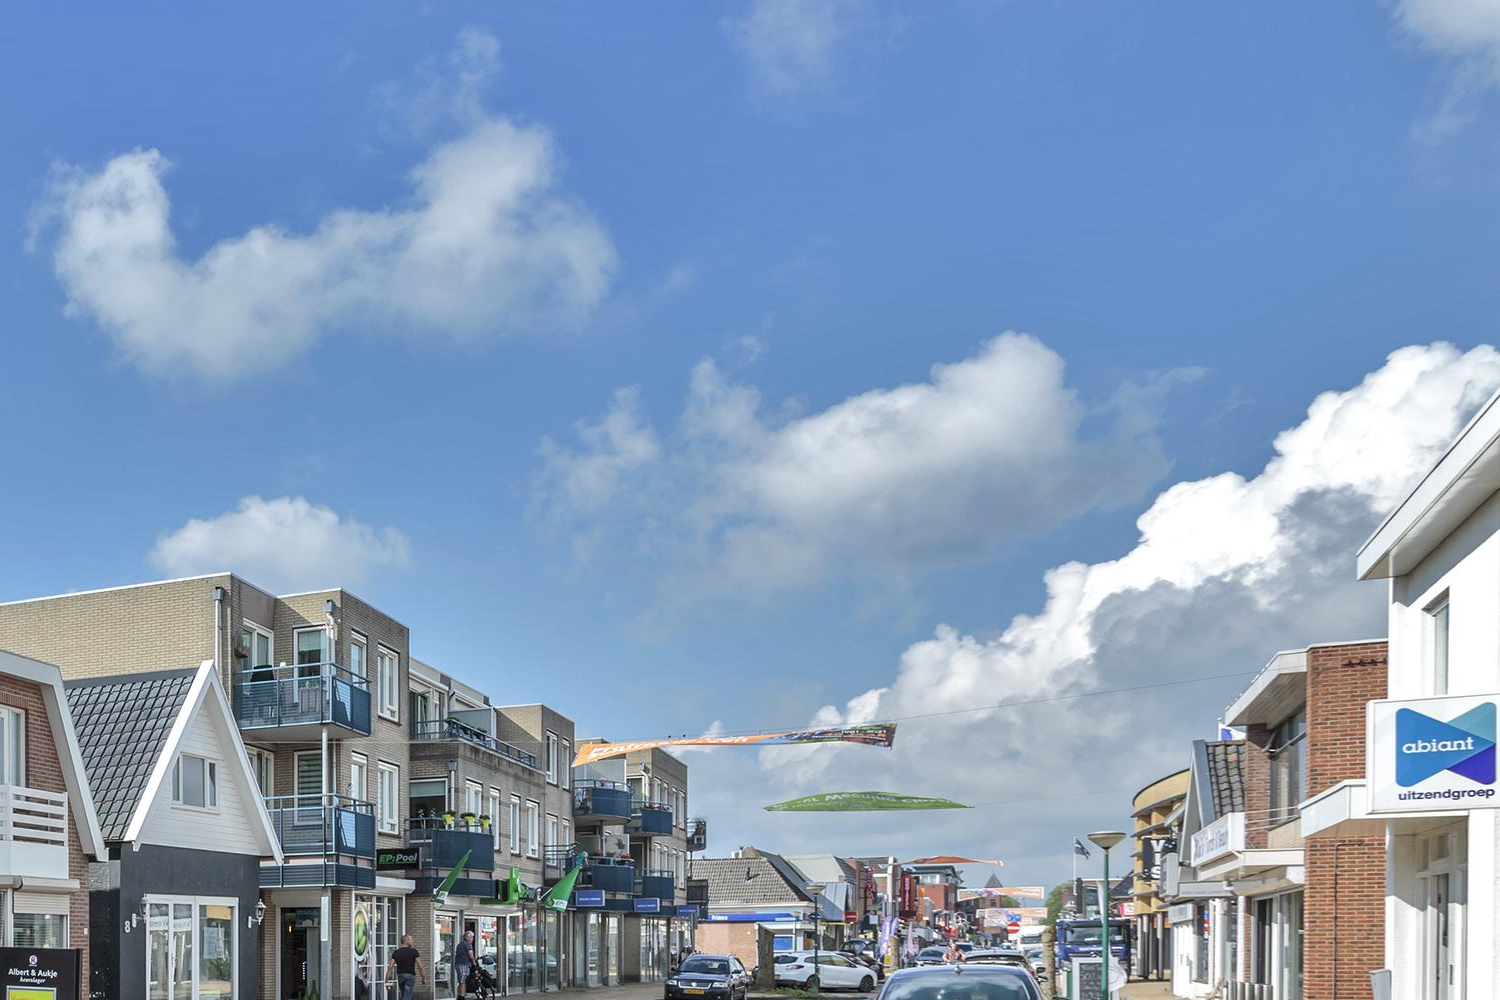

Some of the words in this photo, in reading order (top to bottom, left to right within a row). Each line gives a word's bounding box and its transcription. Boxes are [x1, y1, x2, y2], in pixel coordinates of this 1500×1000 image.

[1402, 736, 1475, 754] abiant
[1398, 788, 1496, 801] uitzendgroep
[125, 921, 131, 933] 8
[8, 968, 30, 977] Albert
[31, 969, 36, 977] &
[37, 969, 58, 978] Aukje
